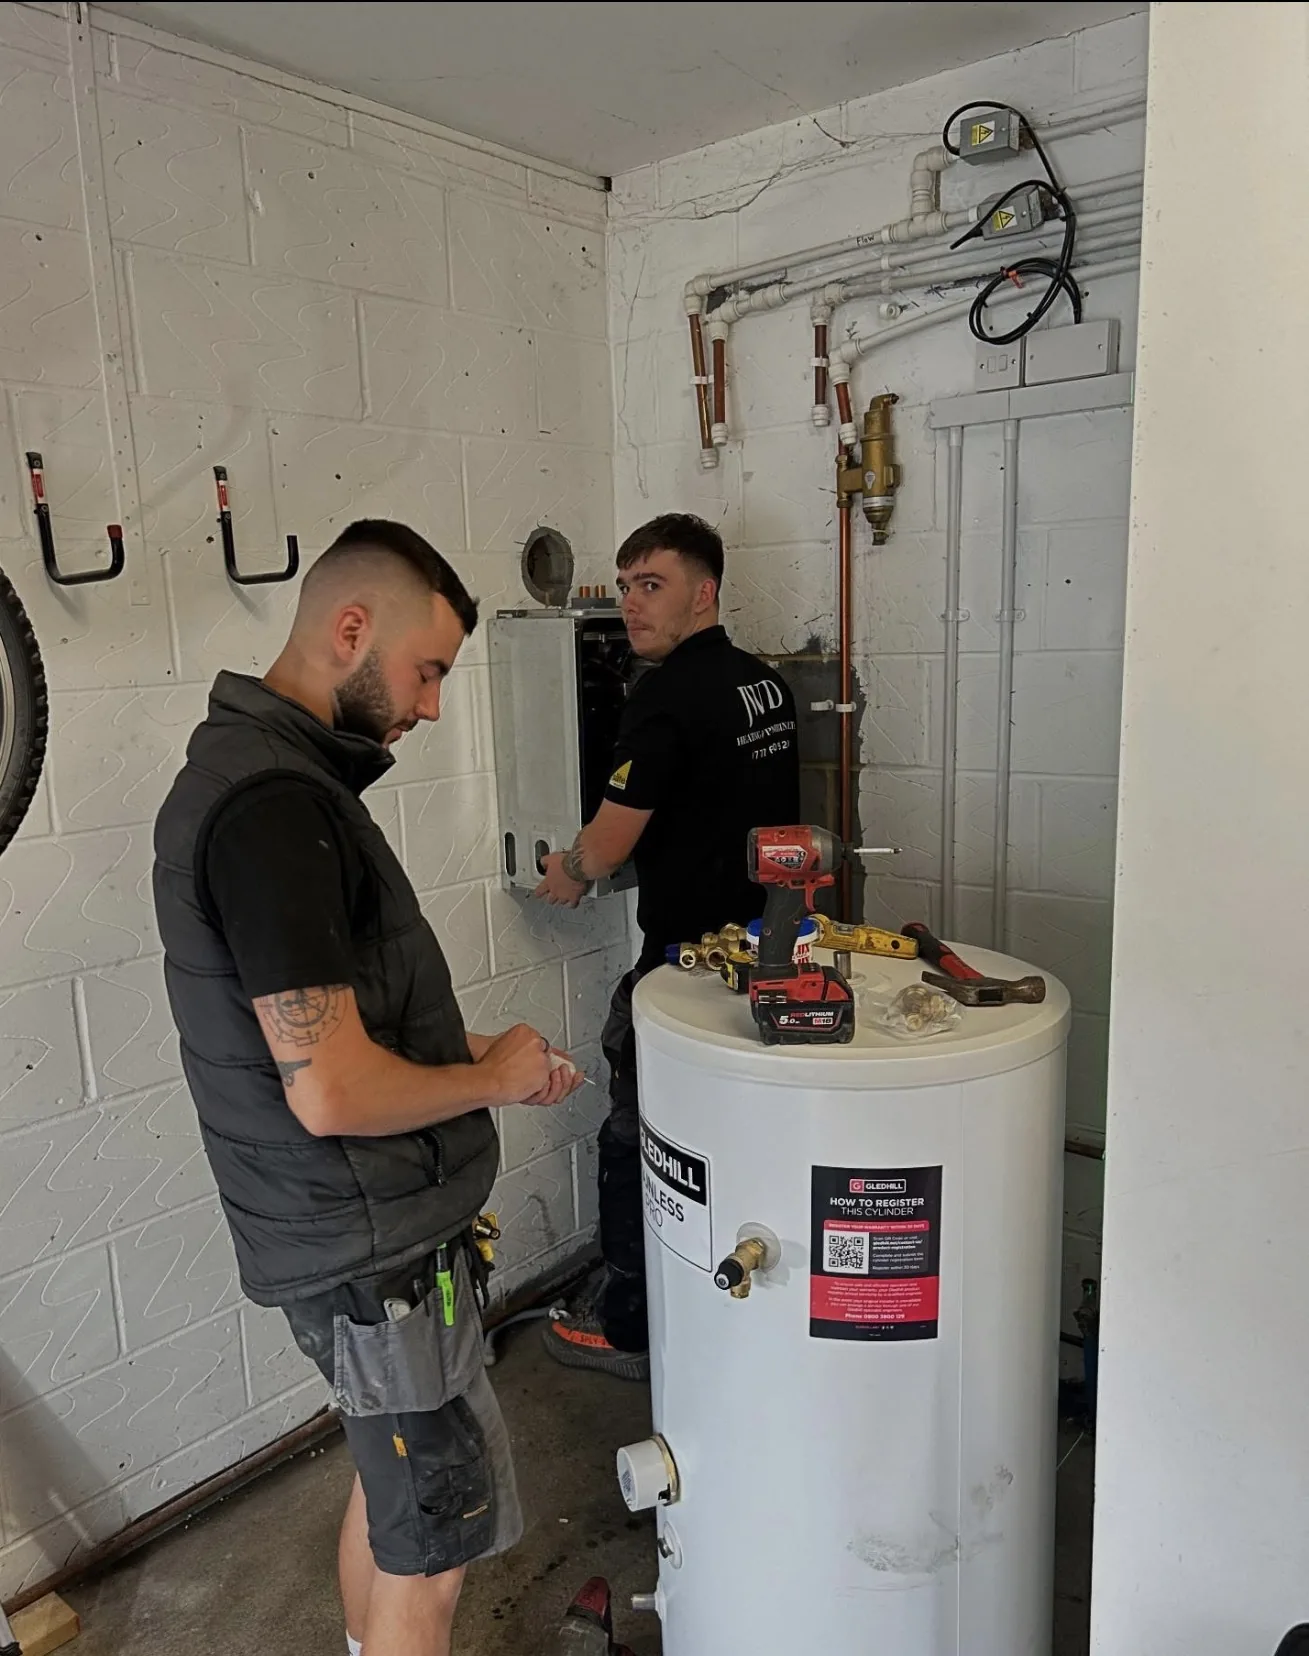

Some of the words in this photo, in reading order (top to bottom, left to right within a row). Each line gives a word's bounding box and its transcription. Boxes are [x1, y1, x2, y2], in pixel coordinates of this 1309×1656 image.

[856, 234, 875, 247] Flow
[737, 679, 783, 728] JWD
[852, 1182, 861, 1190] G
[829, 1197, 857, 1206] HOW
[858, 1199, 873, 1207] TO
[875, 1198, 925, 1207] REGISTER
[841, 1207, 863, 1216] THIS
[864, 1207, 914, 1216] CYLINDER
